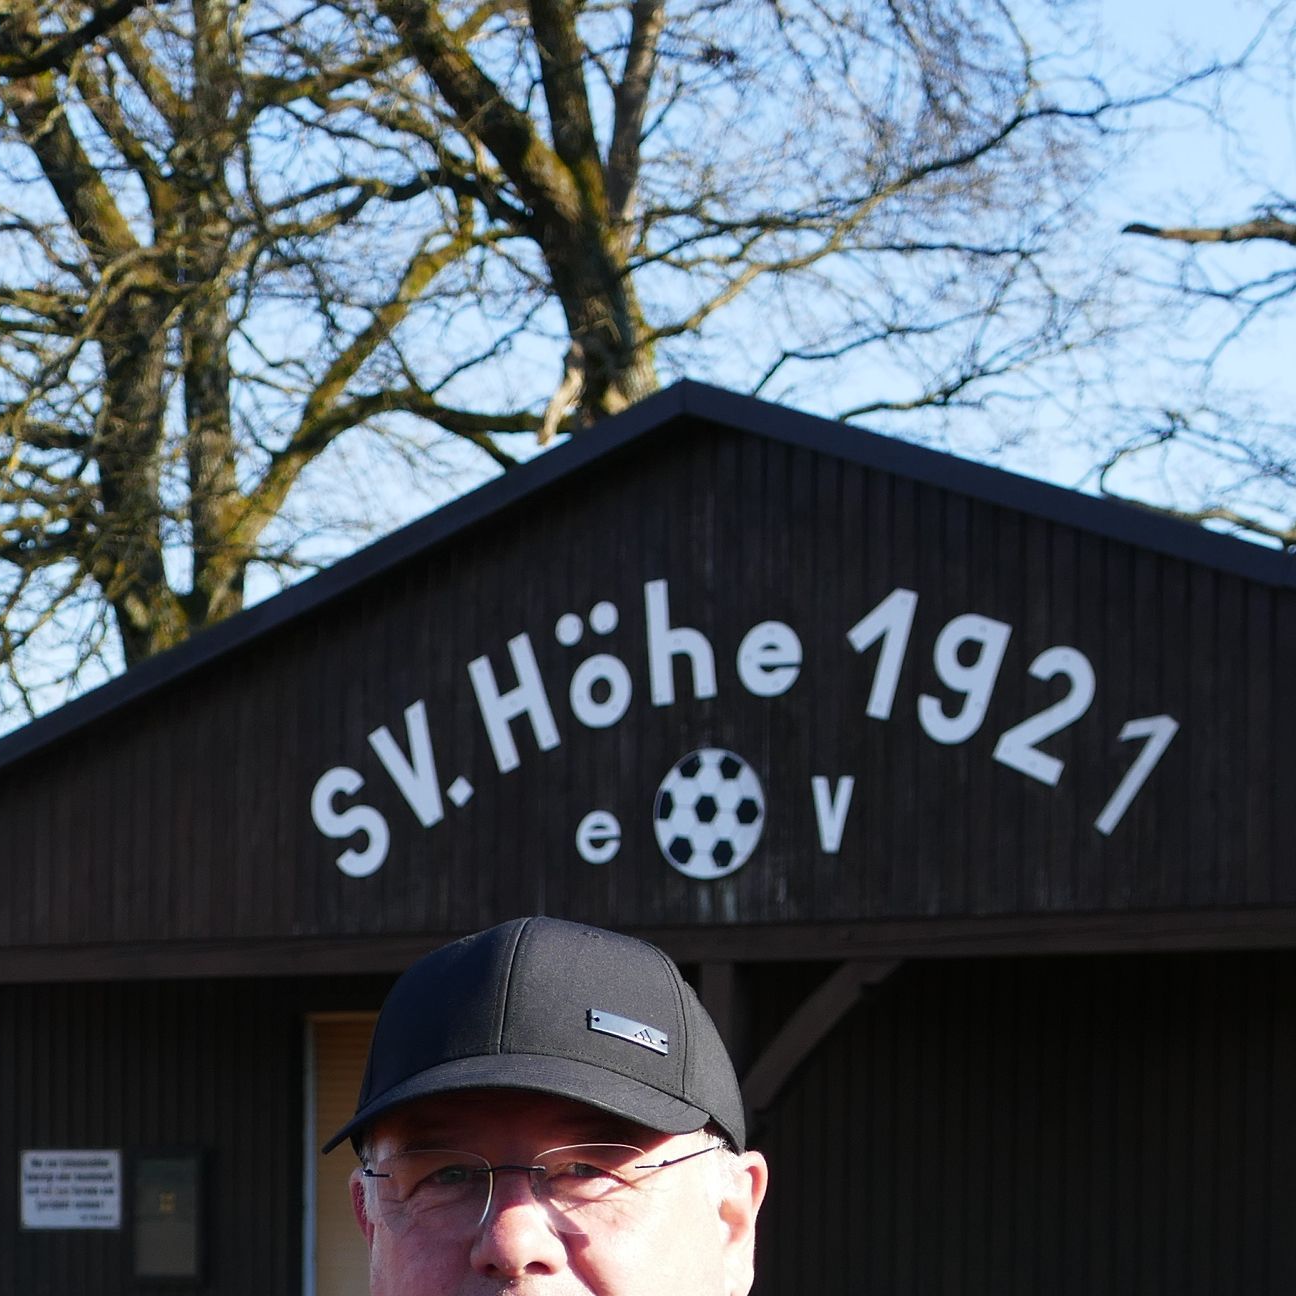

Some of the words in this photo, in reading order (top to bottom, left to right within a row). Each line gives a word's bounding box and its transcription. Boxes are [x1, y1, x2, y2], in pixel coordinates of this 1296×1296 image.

[467, 578, 803, 774] Höhe
[846, 587, 1180, 836] 1921
[575, 809, 622, 864] e
